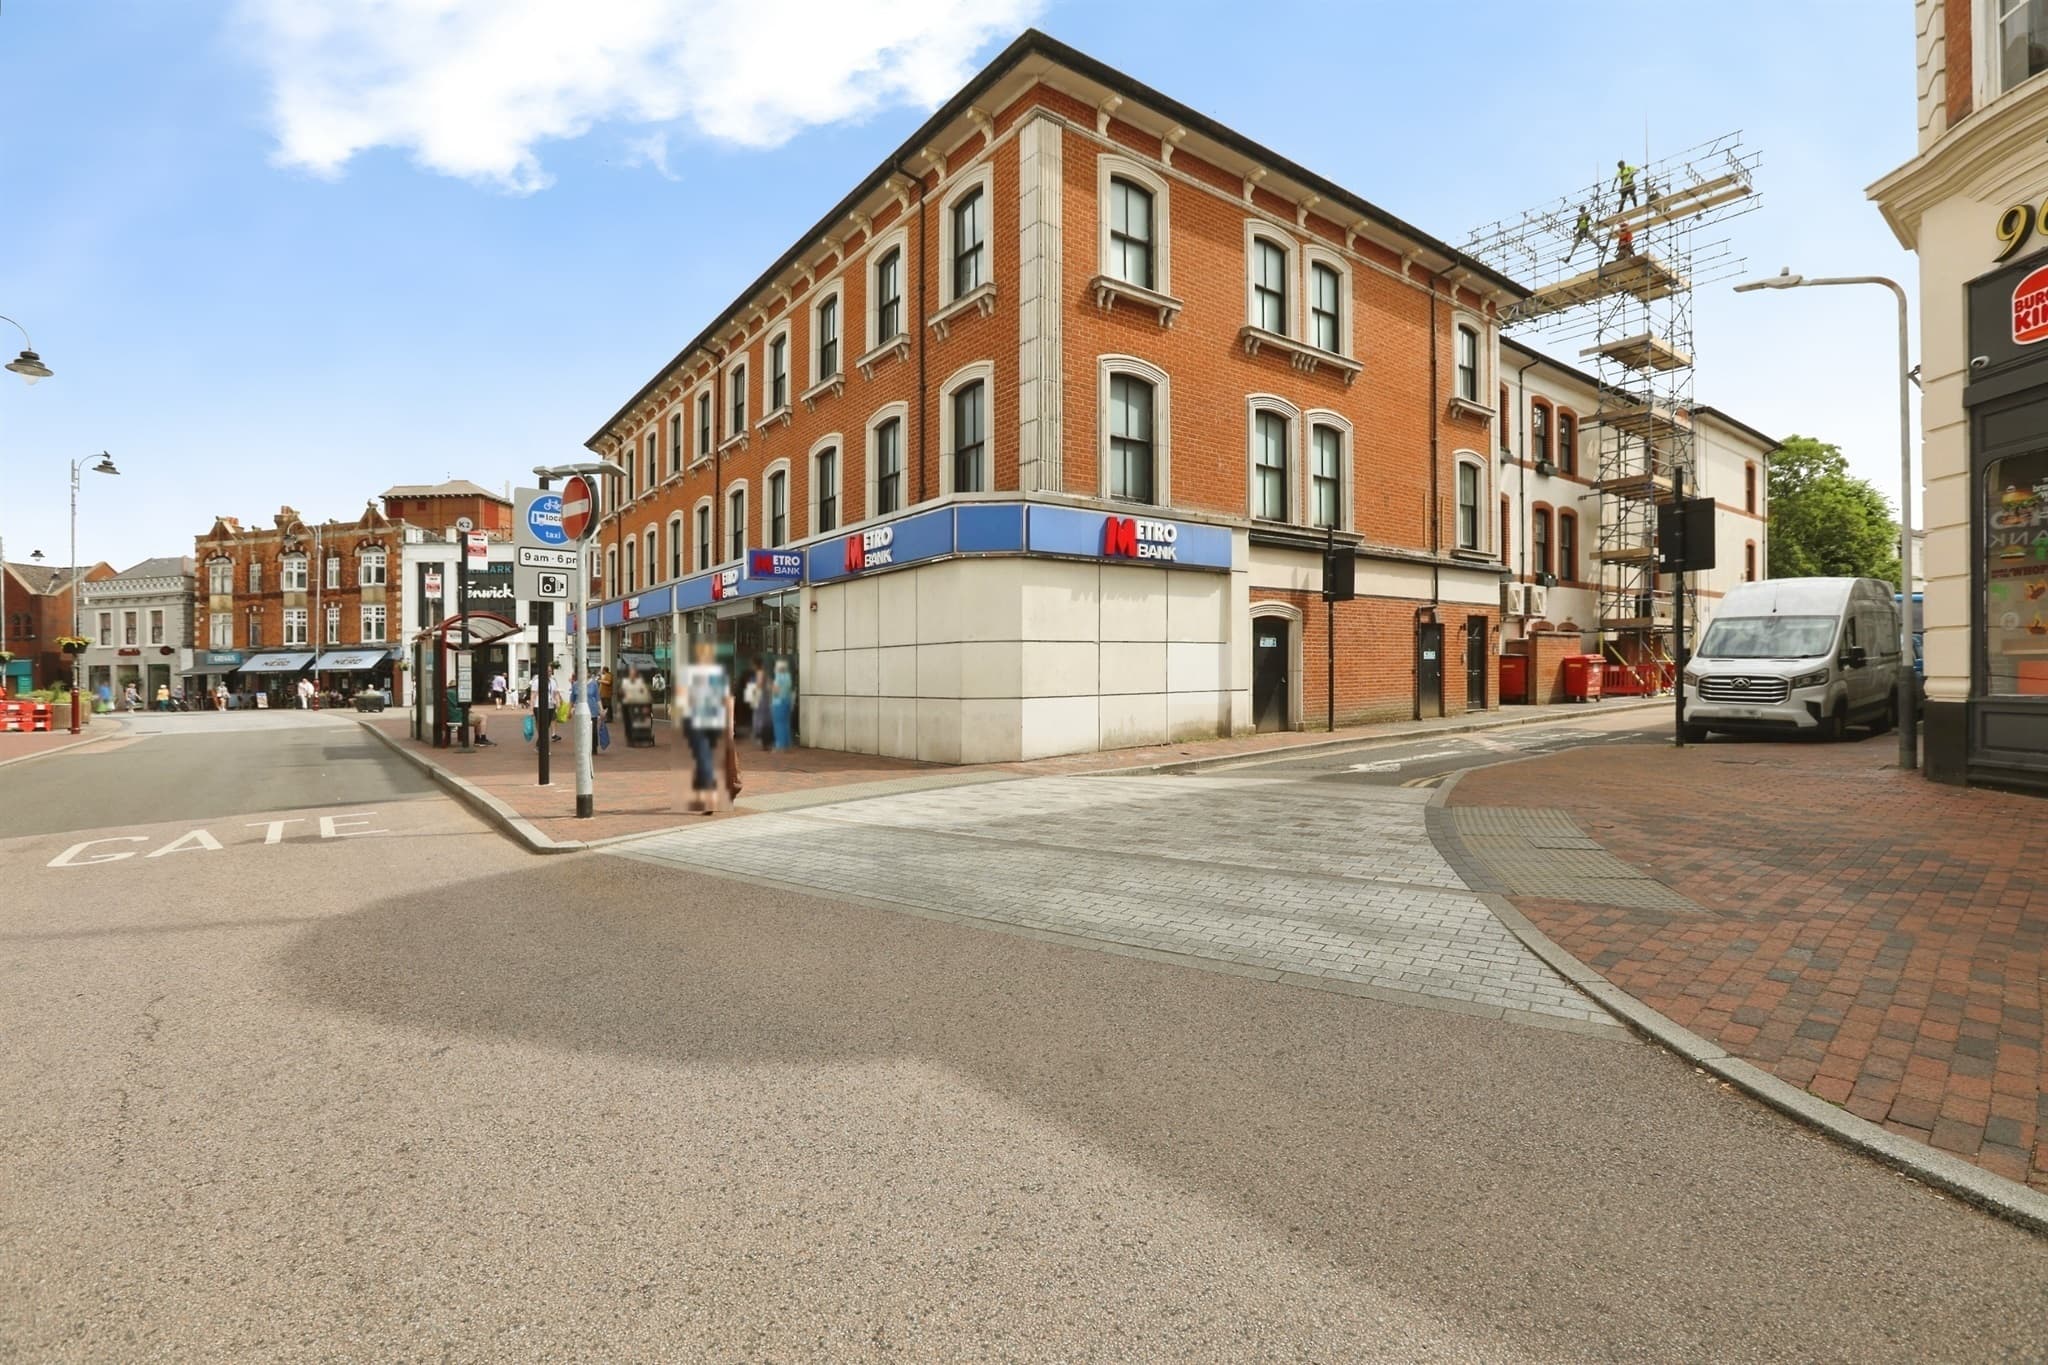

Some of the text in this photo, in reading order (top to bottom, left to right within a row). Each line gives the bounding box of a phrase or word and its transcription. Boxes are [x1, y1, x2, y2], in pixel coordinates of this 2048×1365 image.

[2015, 290, 2048, 314] BUR
[545, 531, 561, 539] taxi
[1104, 516, 1177, 557] METRO
[524, 552, 531, 561] 9
[533, 554, 549, 563] am
[557, 554, 564, 563] 6
[845, 527, 893, 571] METRO
[864, 549, 893, 568] BANK
[1137, 543, 1178, 561] BANK
[754, 554, 800, 573] METRO
[773, 566, 800, 575] BANK
[46, 811, 389, 868] GATE
